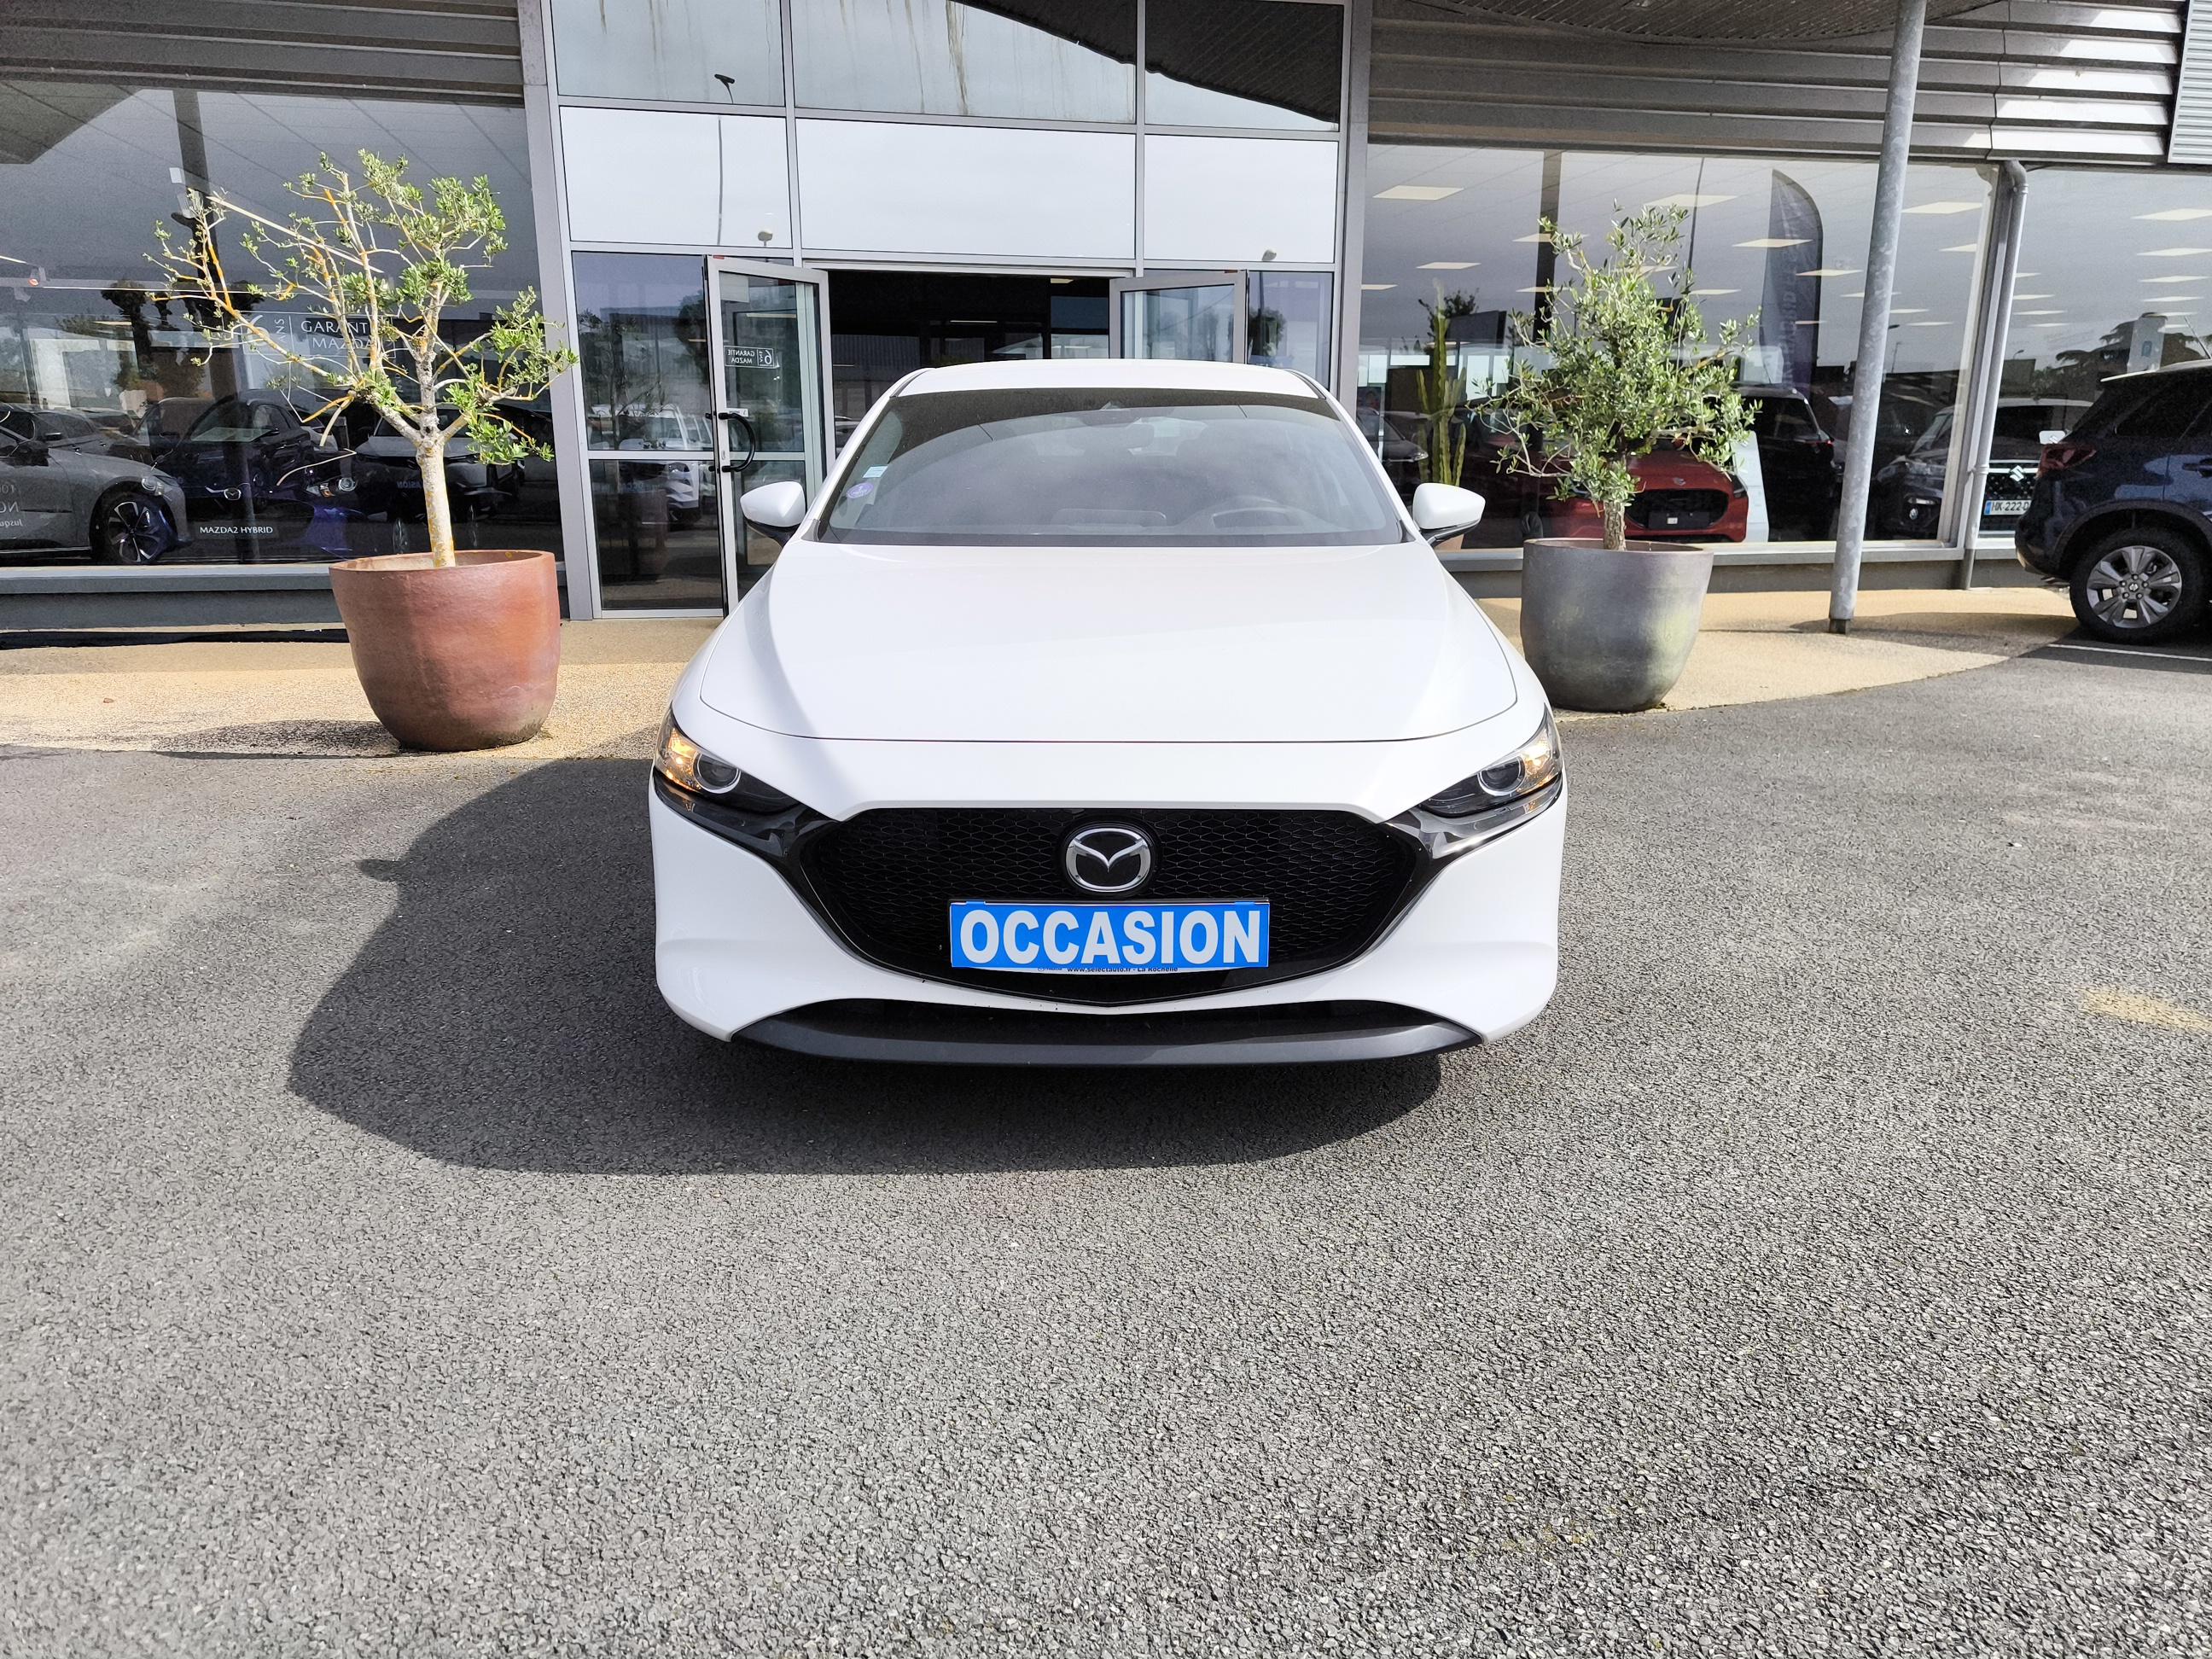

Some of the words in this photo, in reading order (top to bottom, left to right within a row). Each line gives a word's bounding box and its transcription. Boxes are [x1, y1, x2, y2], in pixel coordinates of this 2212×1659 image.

[300, 320, 379, 334] GARNT
[200, 526, 239, 534] MAZDA2
[240, 526, 273, 534] HYBRID
[960, 909, 1260, 965] OCCASION
